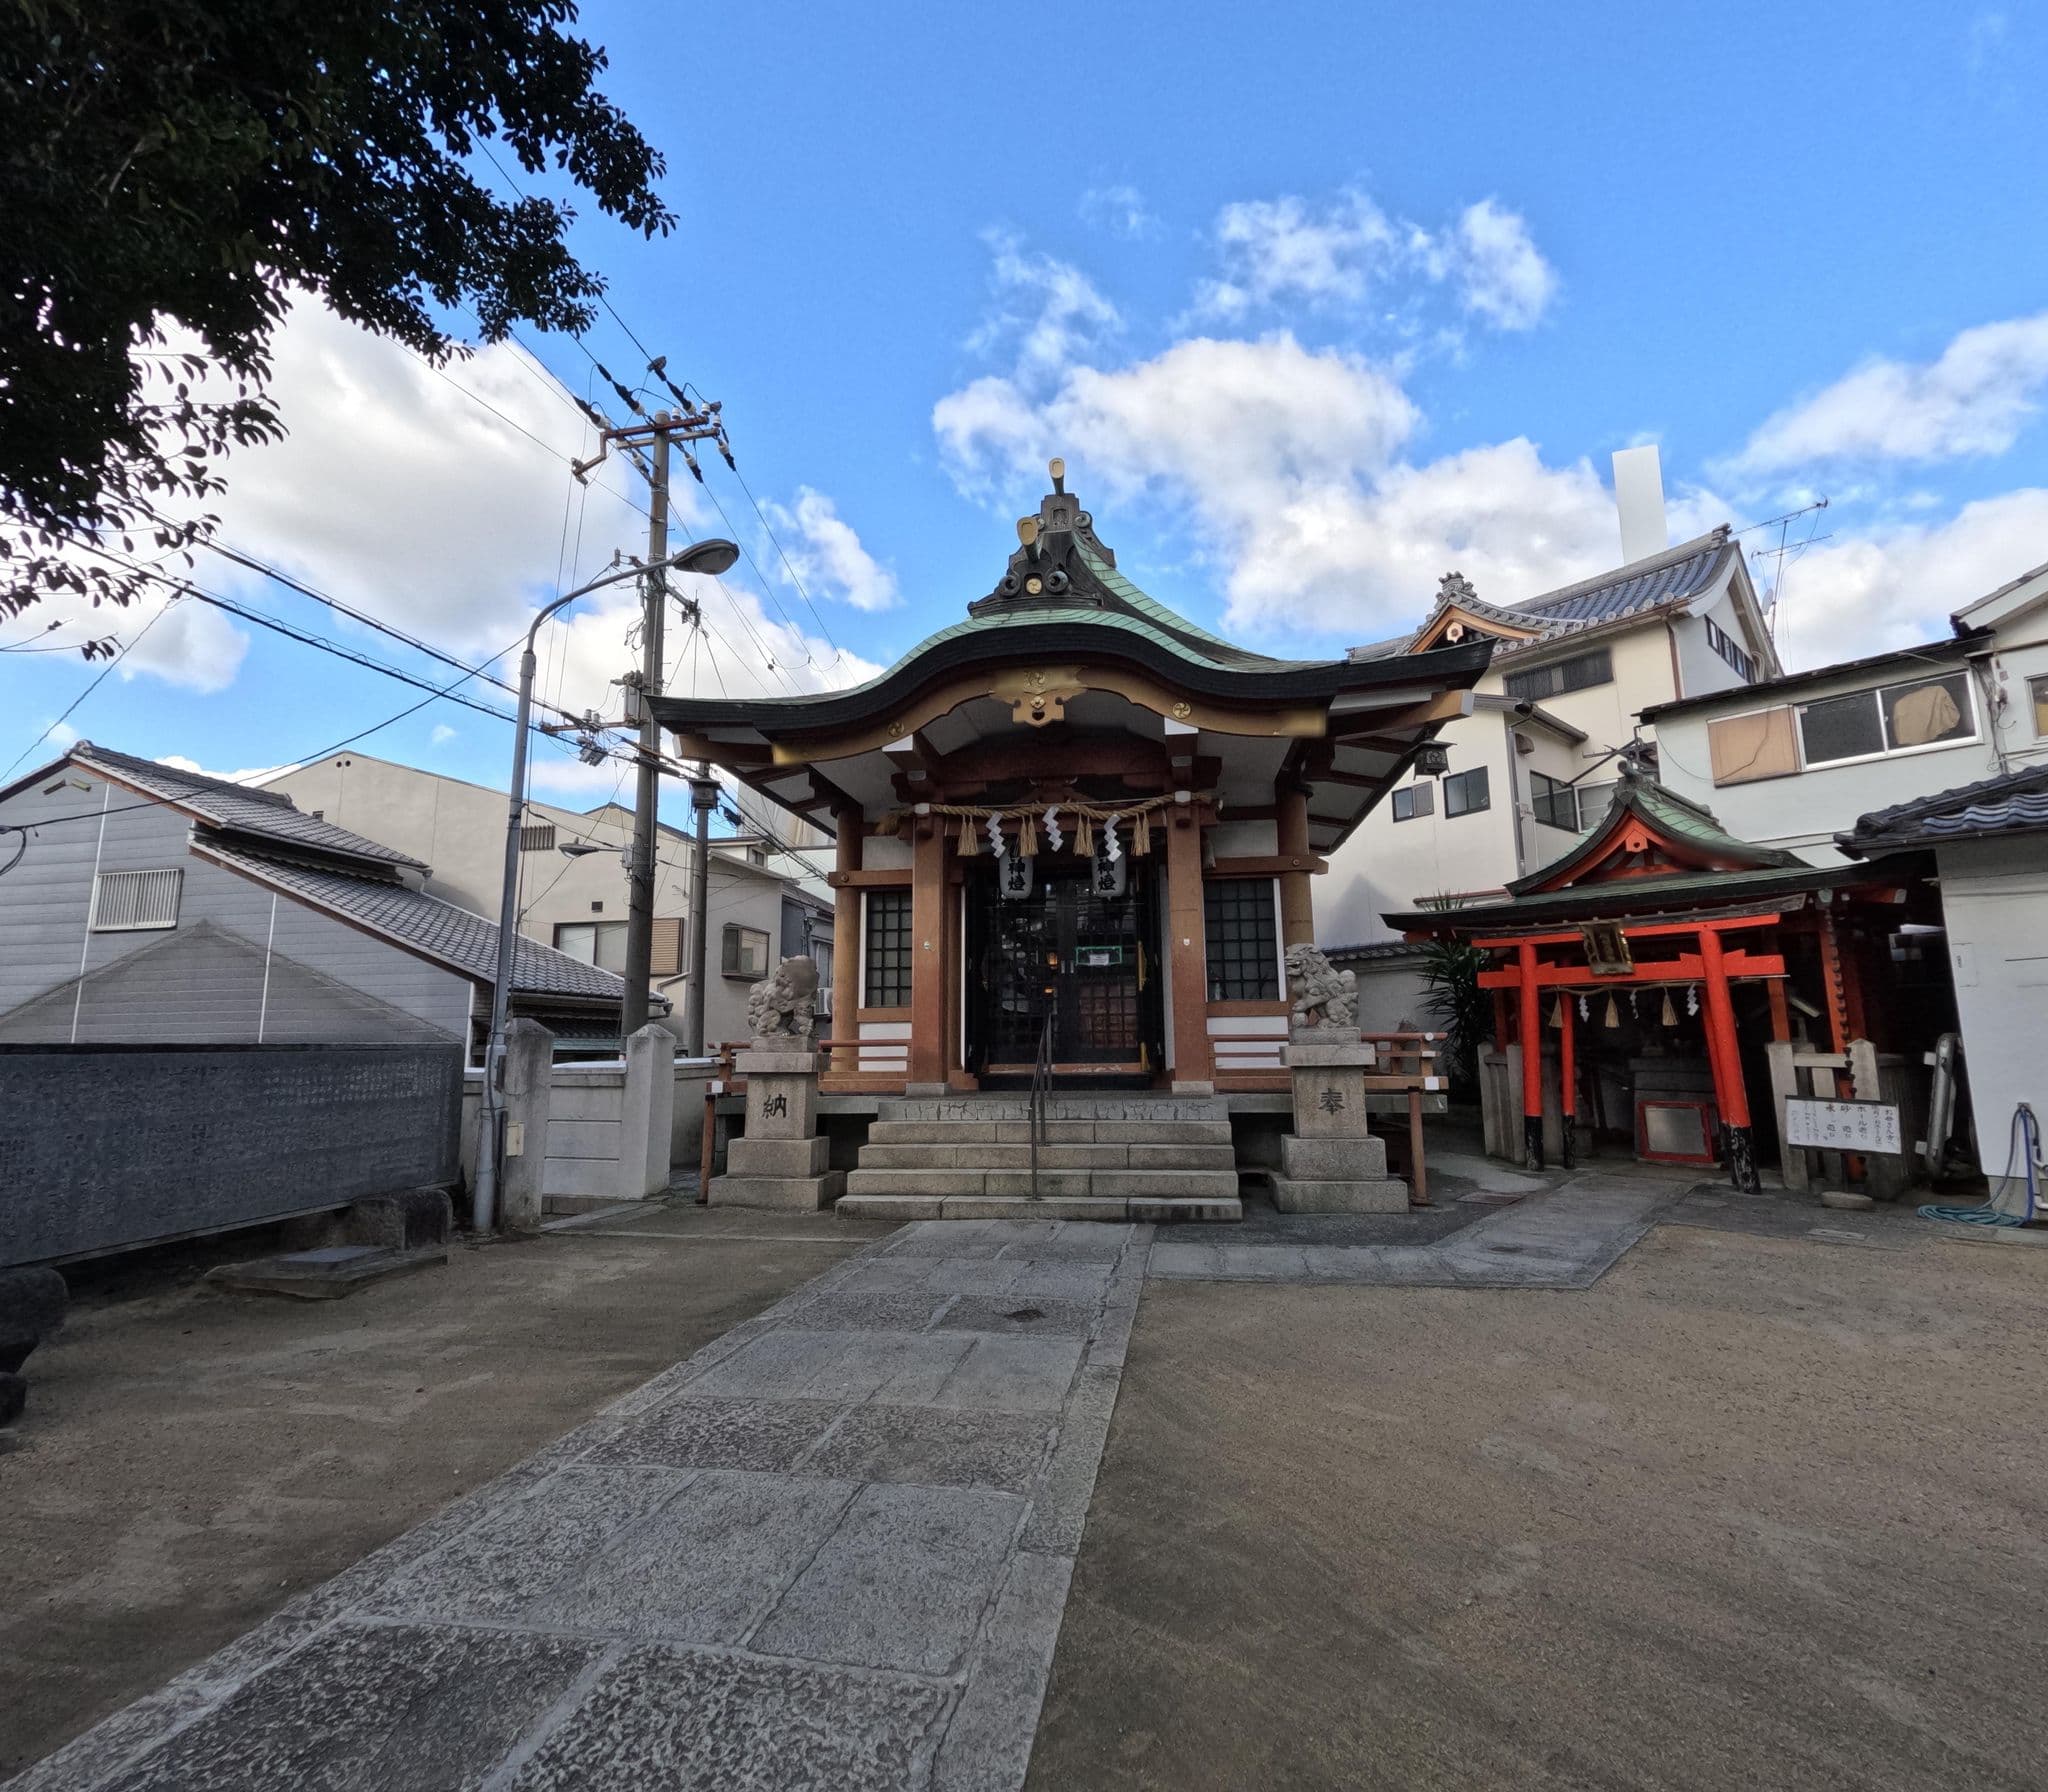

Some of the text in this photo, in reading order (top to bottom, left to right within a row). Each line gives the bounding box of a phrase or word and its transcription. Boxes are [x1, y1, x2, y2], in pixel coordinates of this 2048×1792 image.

[1007, 846, 1027, 892] 神燈
[761, 1093, 787, 1119] 納
[1318, 1087, 1345, 1116] 奉
